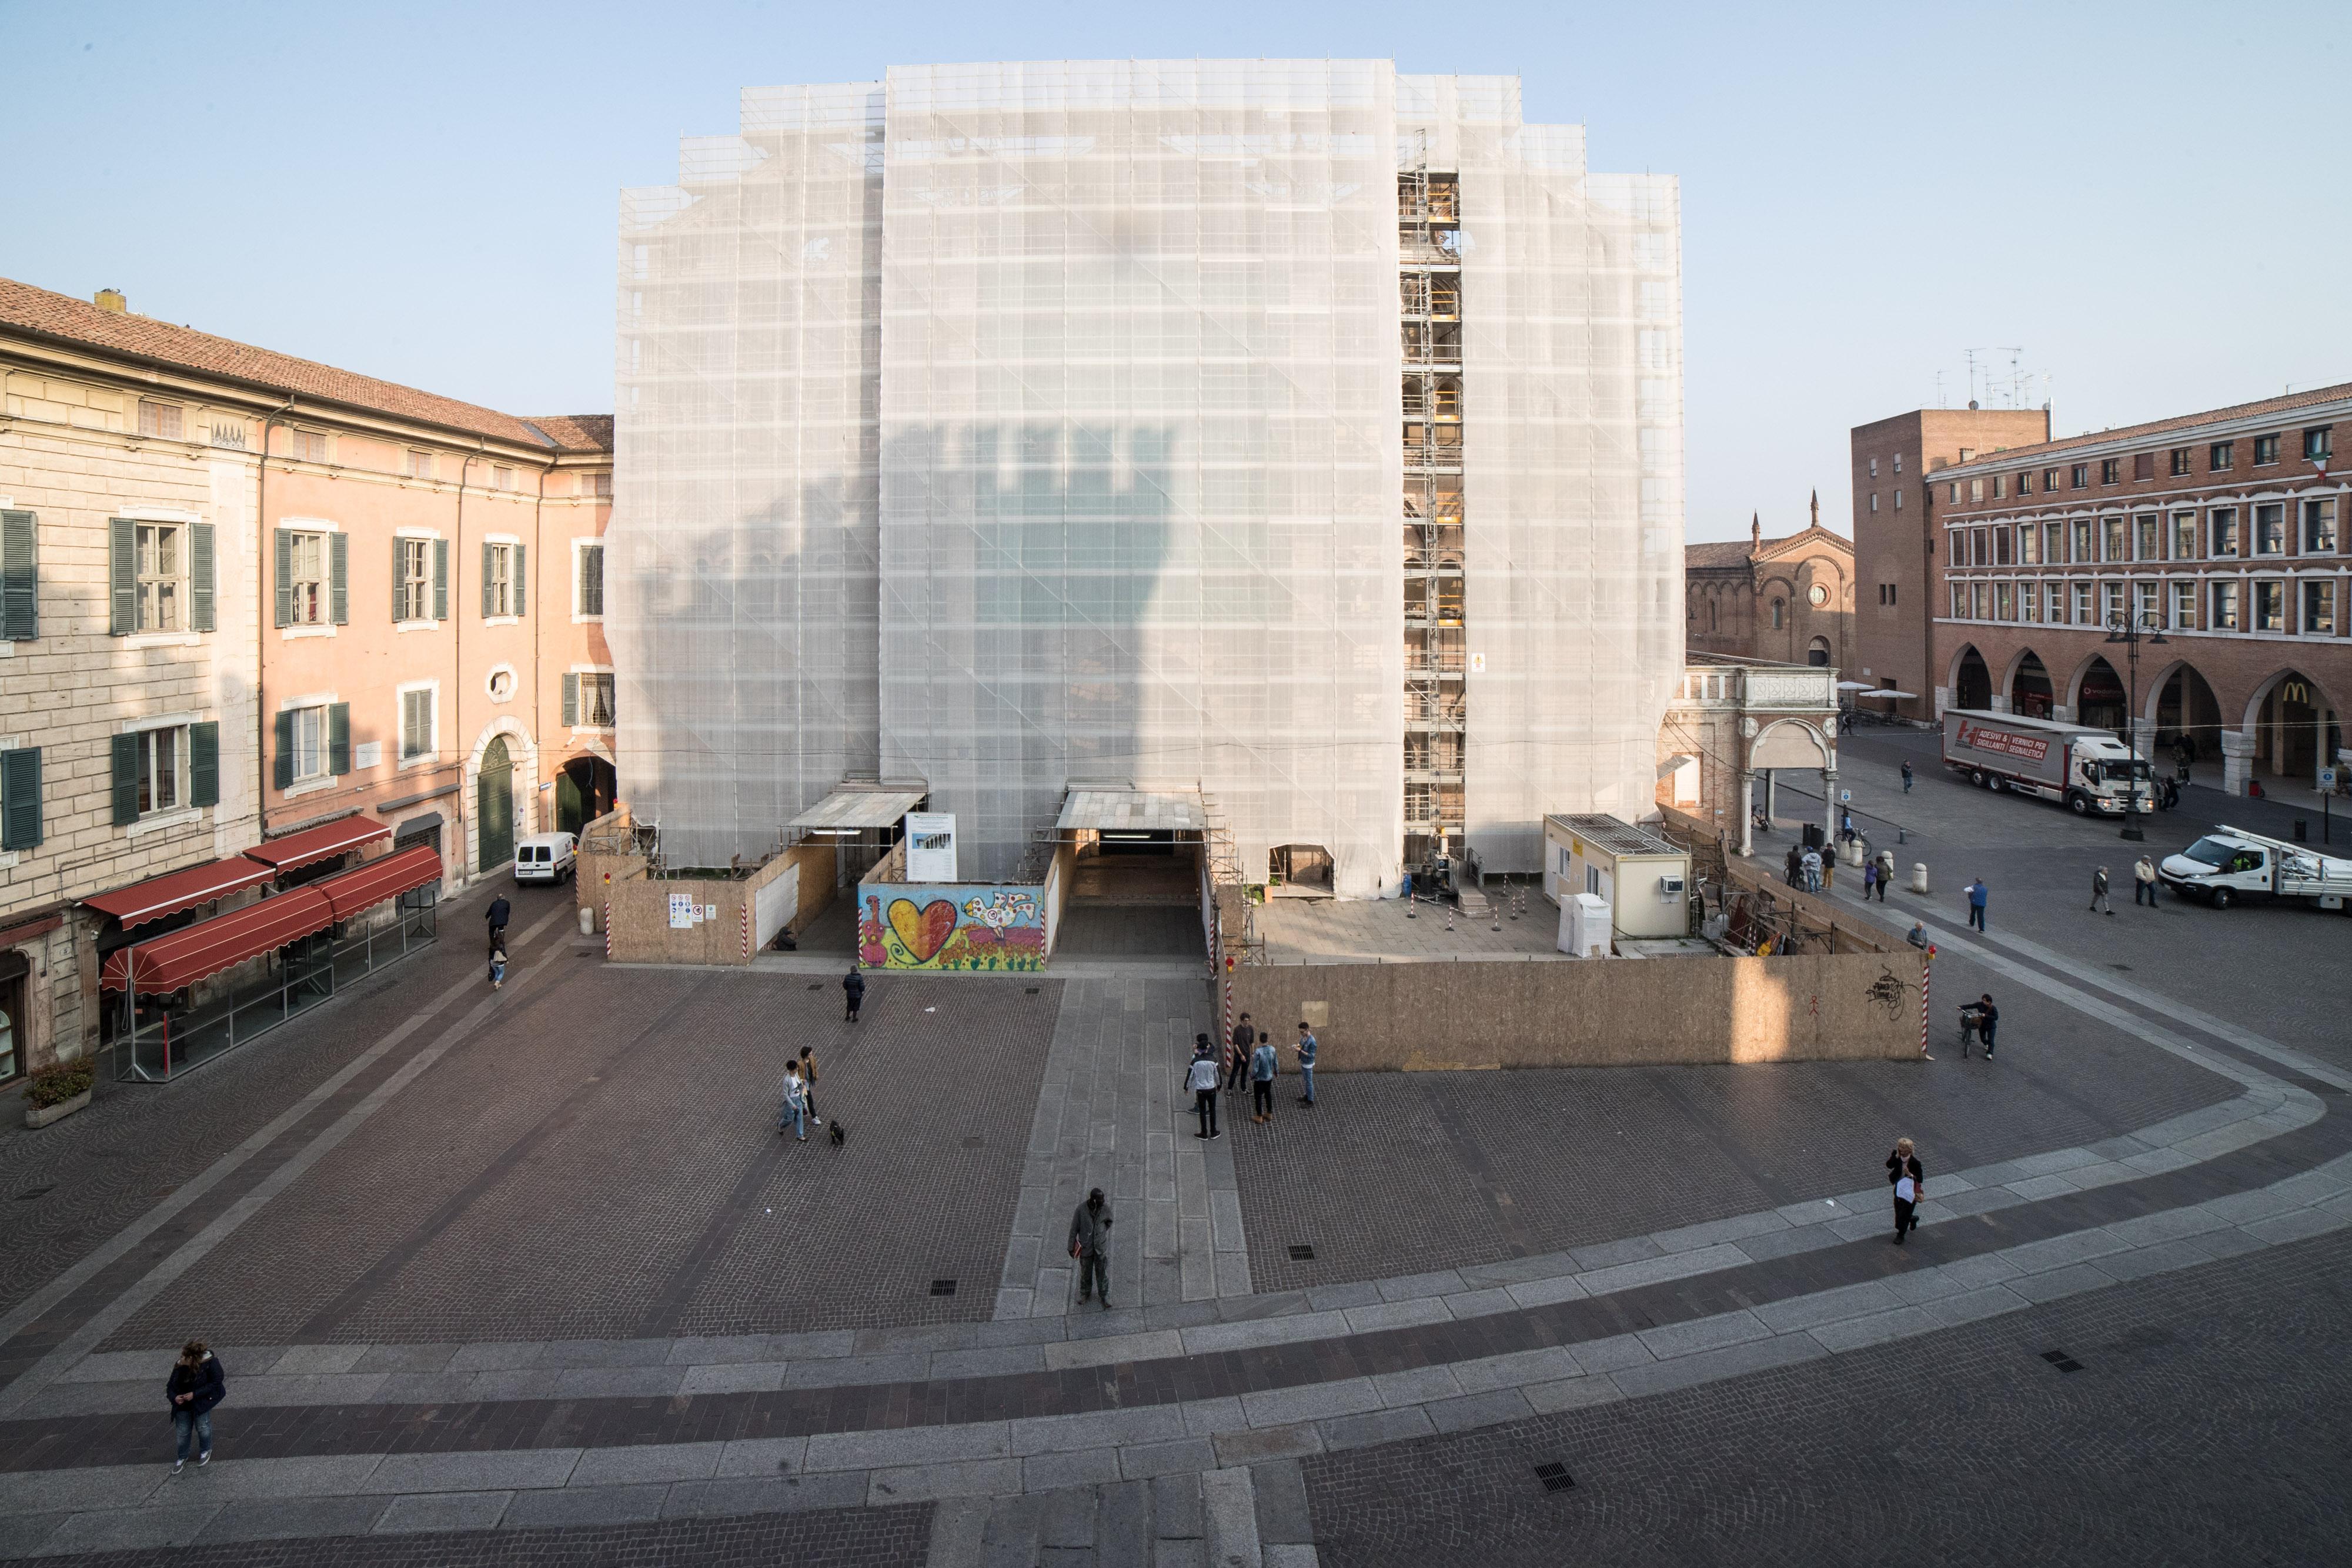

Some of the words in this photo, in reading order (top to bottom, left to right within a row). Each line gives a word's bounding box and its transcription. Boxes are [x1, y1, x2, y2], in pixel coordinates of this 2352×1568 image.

[1979, 731, 2001, 741] ADESIVI
[1976, 738, 2006, 751] SIGILLANTI
[2012, 737, 2034, 747] VERNICI
[2034, 742, 2047, 750] PER
[2009, 745, 2043, 759] SEGNALETICA
